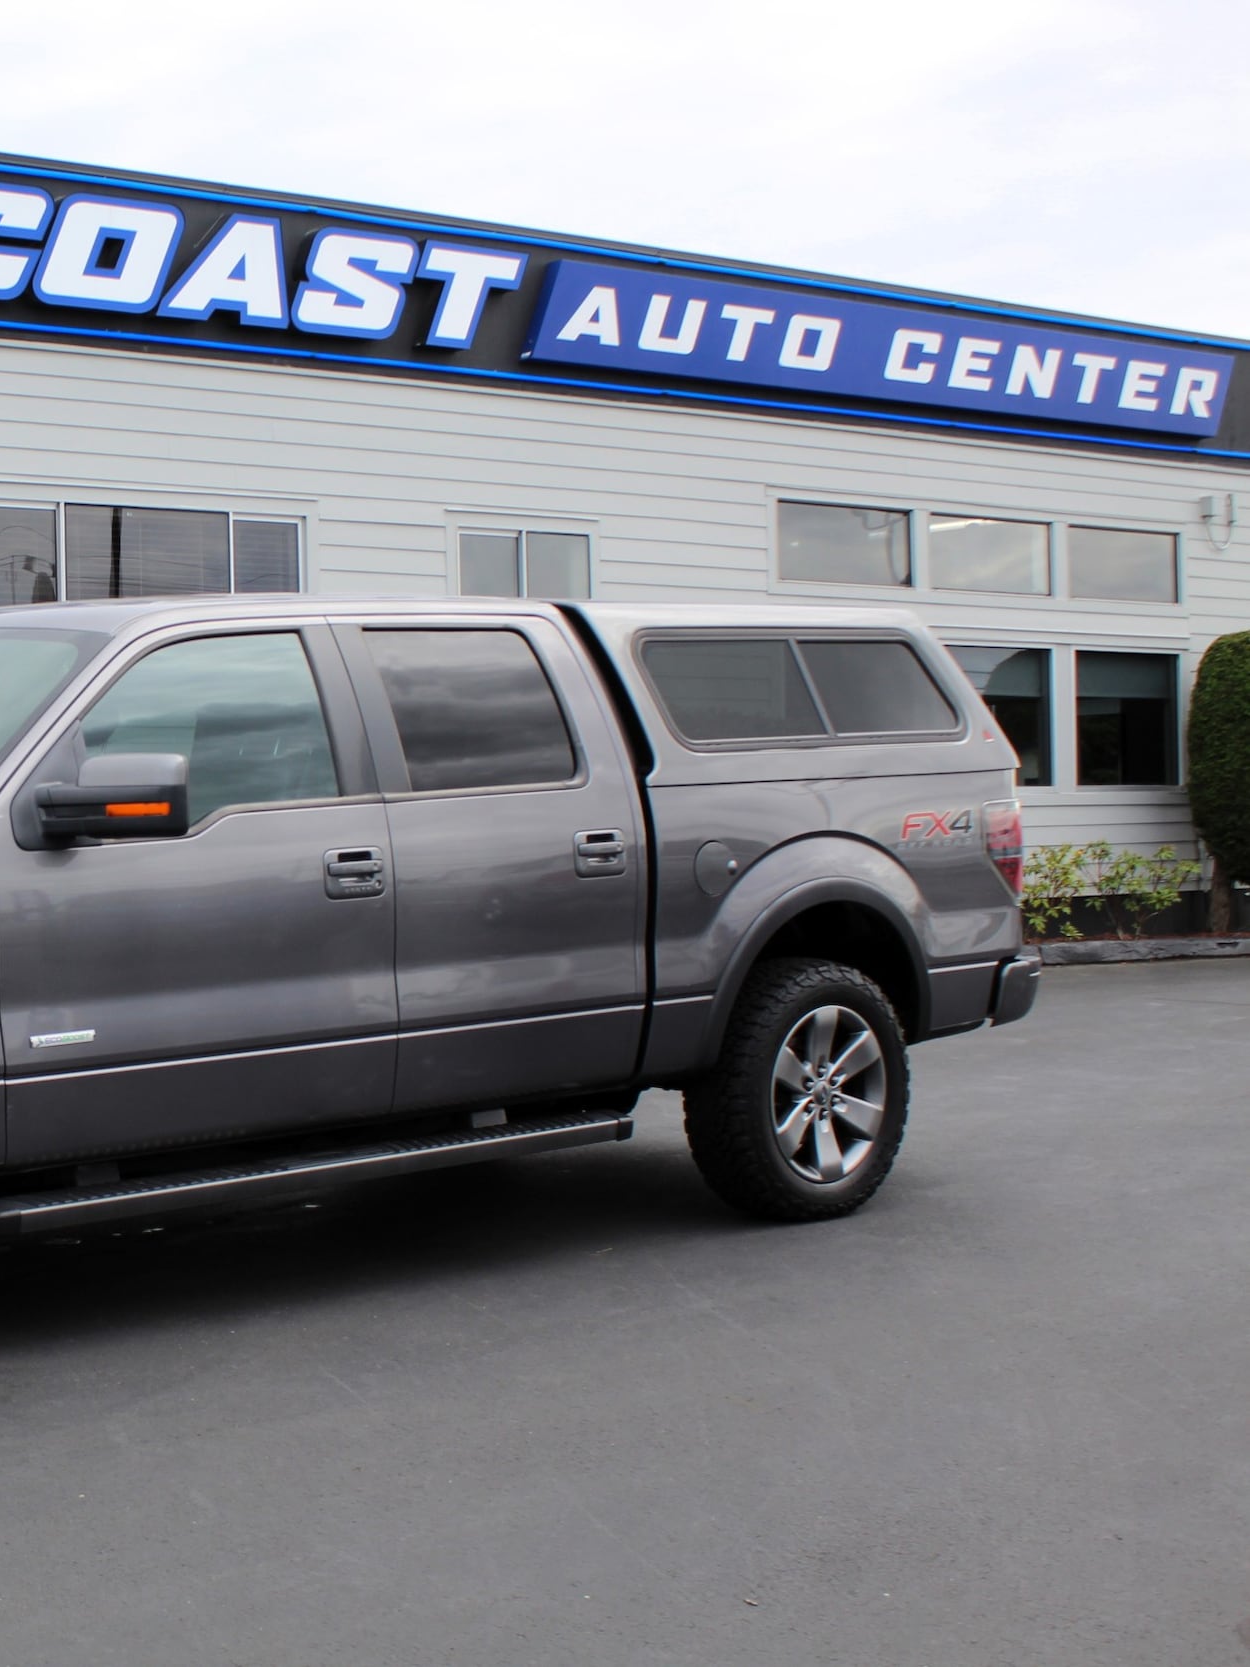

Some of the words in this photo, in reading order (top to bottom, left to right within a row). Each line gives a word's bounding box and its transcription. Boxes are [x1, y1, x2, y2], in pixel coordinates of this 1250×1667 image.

[556, 286, 842, 373] AUTO
[884, 328, 1218, 419] CENTER
[901, 809, 972, 839] FX4
